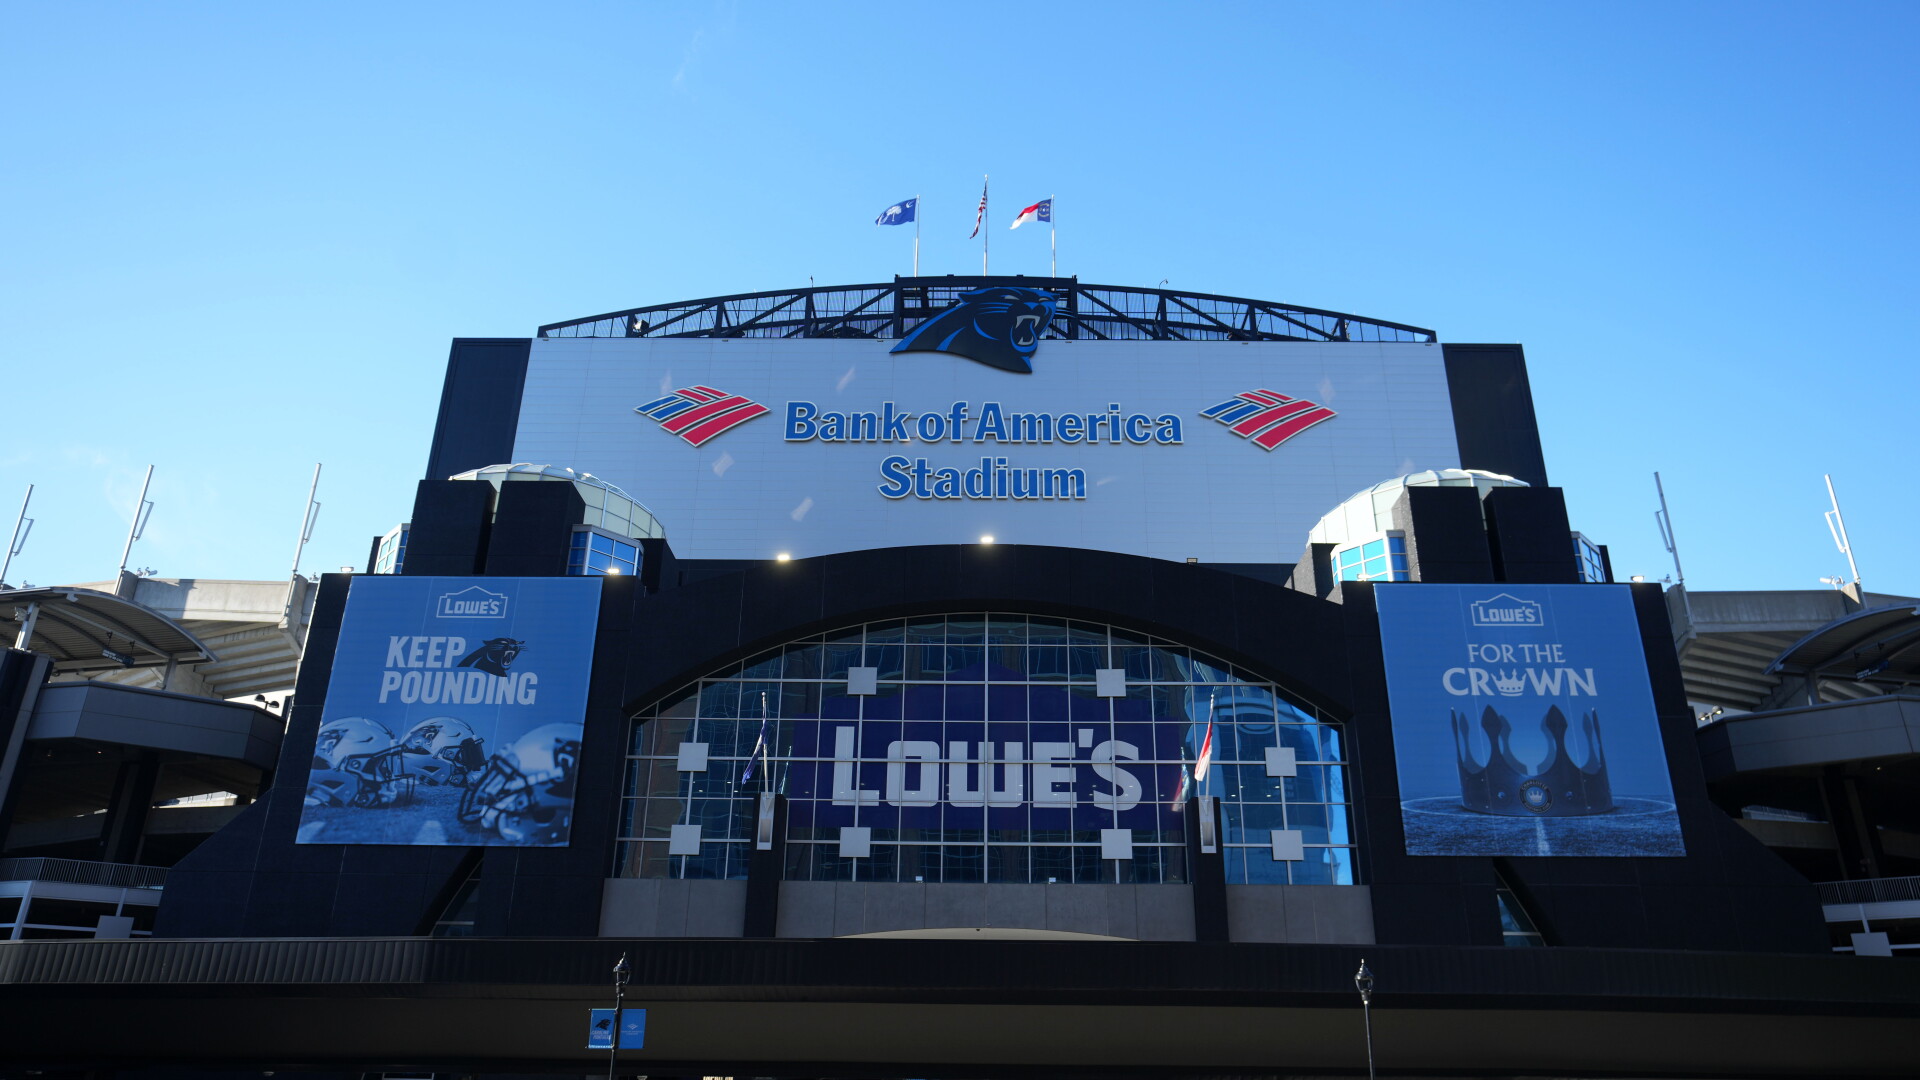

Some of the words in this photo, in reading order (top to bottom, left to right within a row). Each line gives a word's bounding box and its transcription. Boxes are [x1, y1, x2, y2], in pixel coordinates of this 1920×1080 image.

[784, 400, 911, 441] Bank
[916, 400, 969, 442] of
[973, 402, 1184, 443] America
[877, 455, 1087, 499] Stadium
[444, 598, 500, 615] LOWE'S
[1478, 606, 1536, 623] LOWE'S
[385, 635, 467, 669] KEEP
[1467, 644, 1517, 663] FOR
[1518, 644, 1566, 663] THE
[378, 670, 539, 706] POUNDING
[832, 726, 1143, 811] LOWE'S
